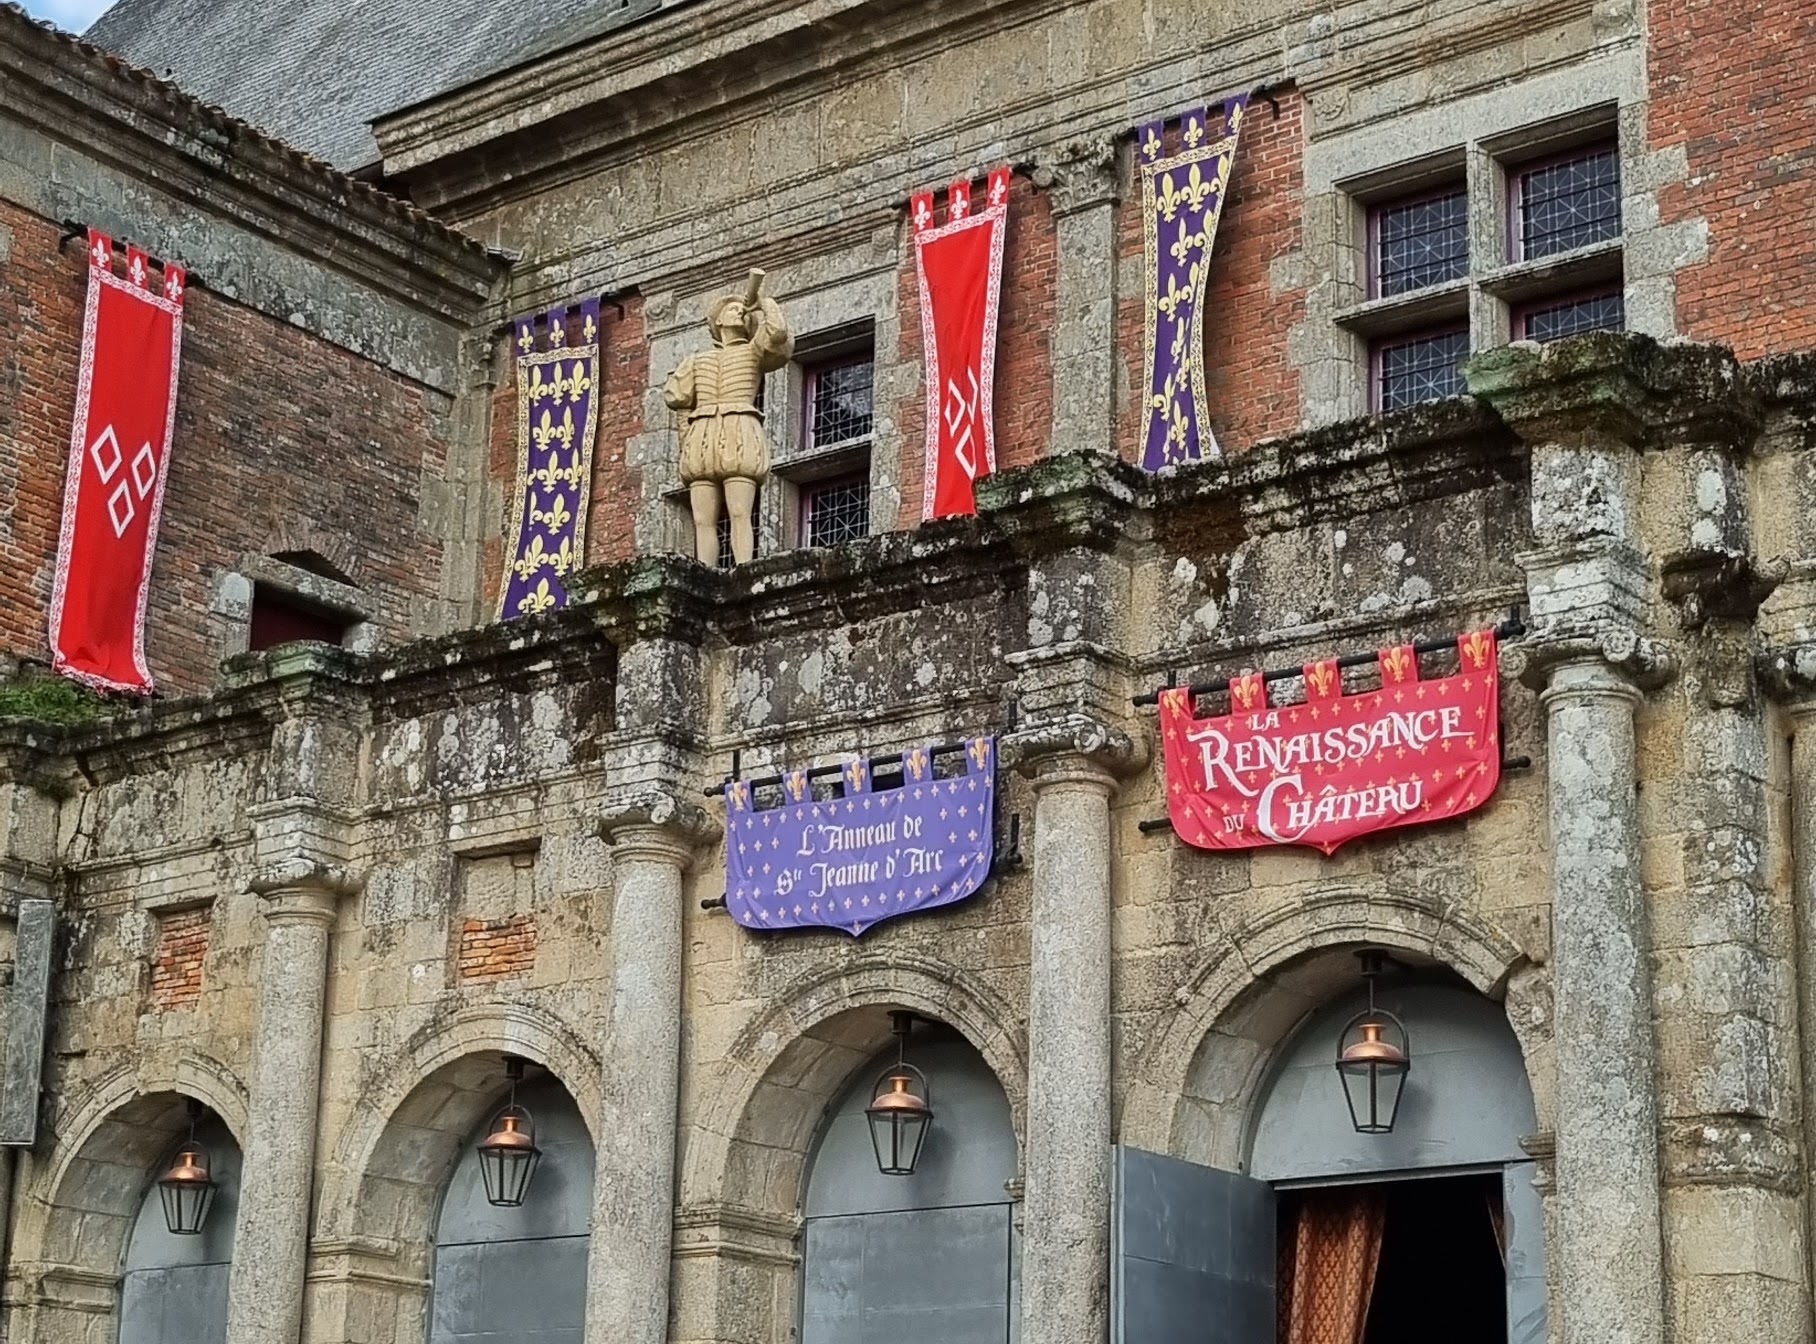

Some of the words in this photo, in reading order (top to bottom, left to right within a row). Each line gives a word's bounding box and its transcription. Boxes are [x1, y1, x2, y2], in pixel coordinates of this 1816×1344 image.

[1250, 711, 1280, 732] LA
[1188, 706, 1474, 797] RENAISSANCE
[797, 821, 896, 856] L'Anneau
[903, 814, 923, 839] de
[1223, 813, 1246, 833] DU
[808, 861, 879, 898] Jeanne
[885, 847, 944, 880] d'Arc
